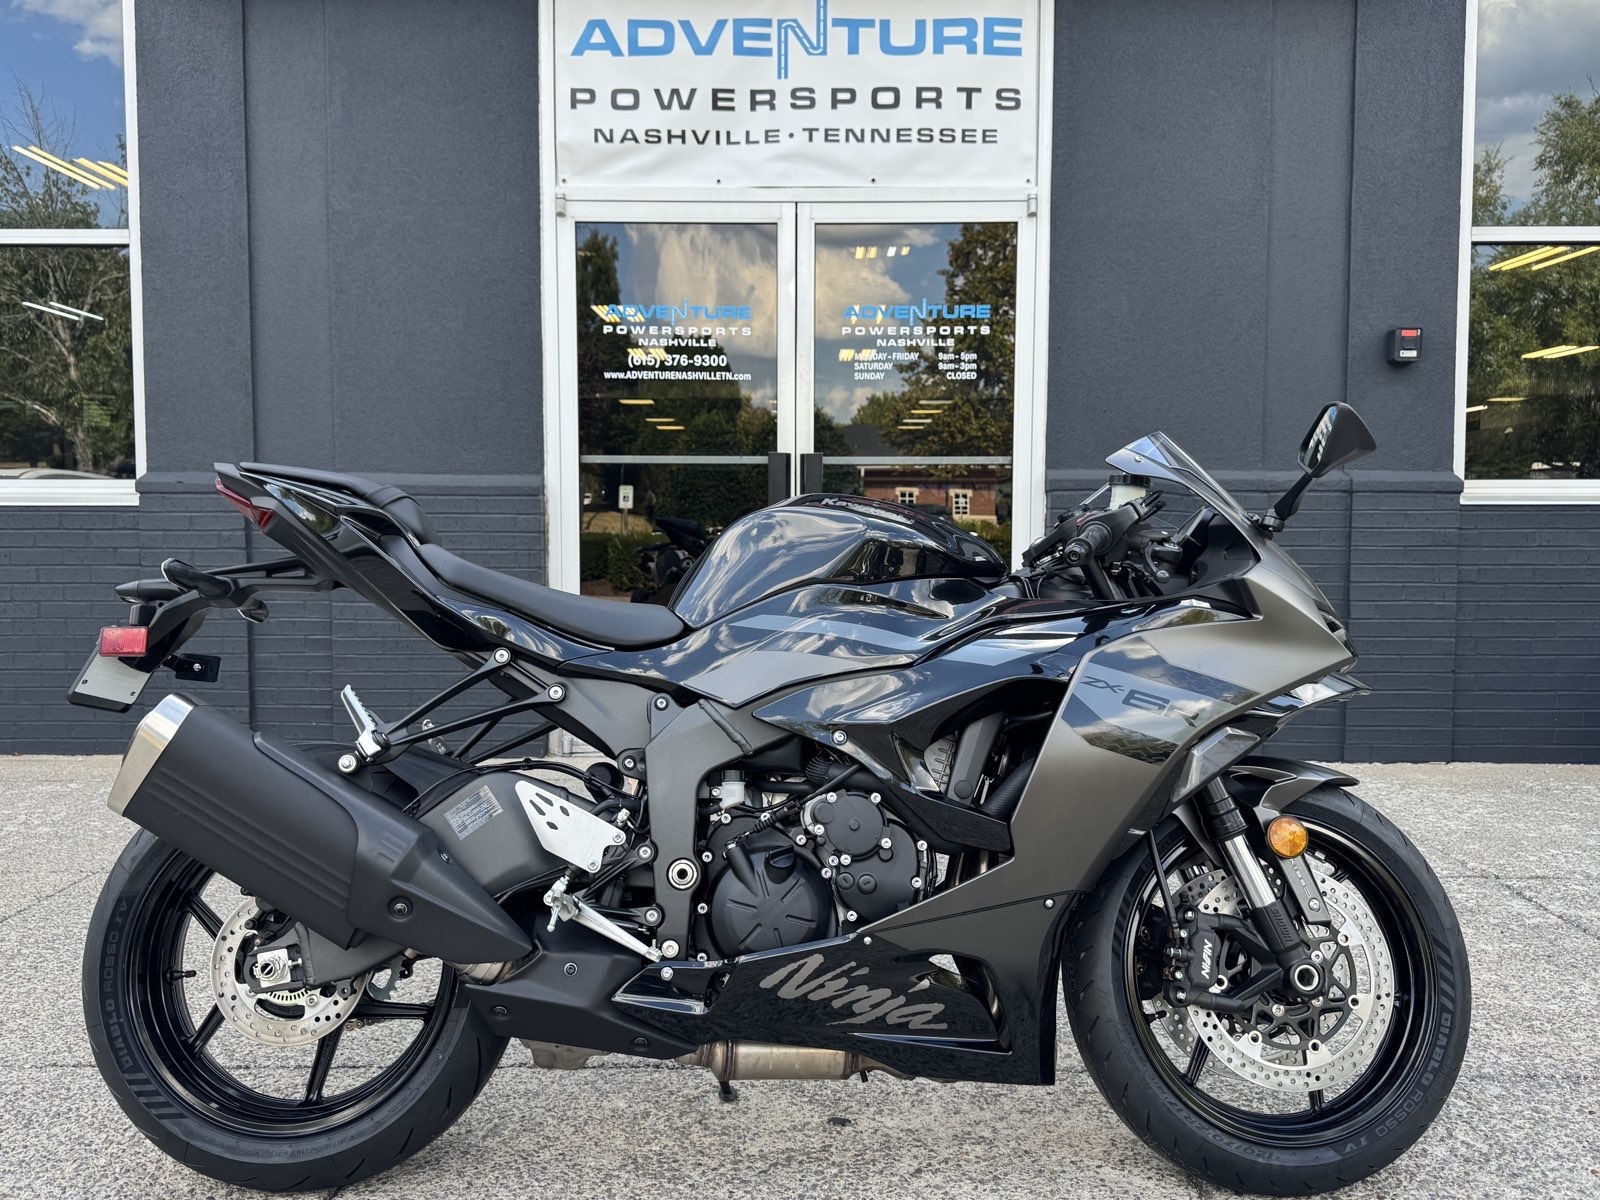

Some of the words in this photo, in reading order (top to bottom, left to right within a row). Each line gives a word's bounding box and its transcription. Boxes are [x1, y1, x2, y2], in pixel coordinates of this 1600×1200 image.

[571, 0, 1023, 79] ADVENTURE
[570, 86, 1022, 112] POWERSPORTS
[593, 128, 781, 146] NASHVILLE
[802, 127, 999, 145] TENNESSEE
[606, 298, 752, 326] ADVENTURE
[842, 298, 992, 326] ADVENTURE
[602, 325, 752, 336] POWERSPORTS
[841, 325, 991, 336] POWERSPORTS
[638, 338, 717, 348] NASHVILLE
[876, 338, 955, 347] NASHVILLE
[664, 354, 728, 367] 376-9300
[893, 352, 920, 361] FRIDAY
[938, 352, 955, 360] 9am
[854, 362, 893, 370] SATURDAY
[938, 362, 955, 370] 9am
[604, 370, 752, 381] www.ADVENTURENASHVILLETN.com
[854, 371, 885, 380] SUNDAY
[946, 371, 978, 380] CLOSED
[104, 930, 119, 992] ROSSO
[759, 953, 948, 1030] Ninja
[105, 1000, 134, 1069] DIABLO
[1421, 1012, 1452, 1086] DIABLO
[1375, 1089, 1424, 1137] ROSSO
